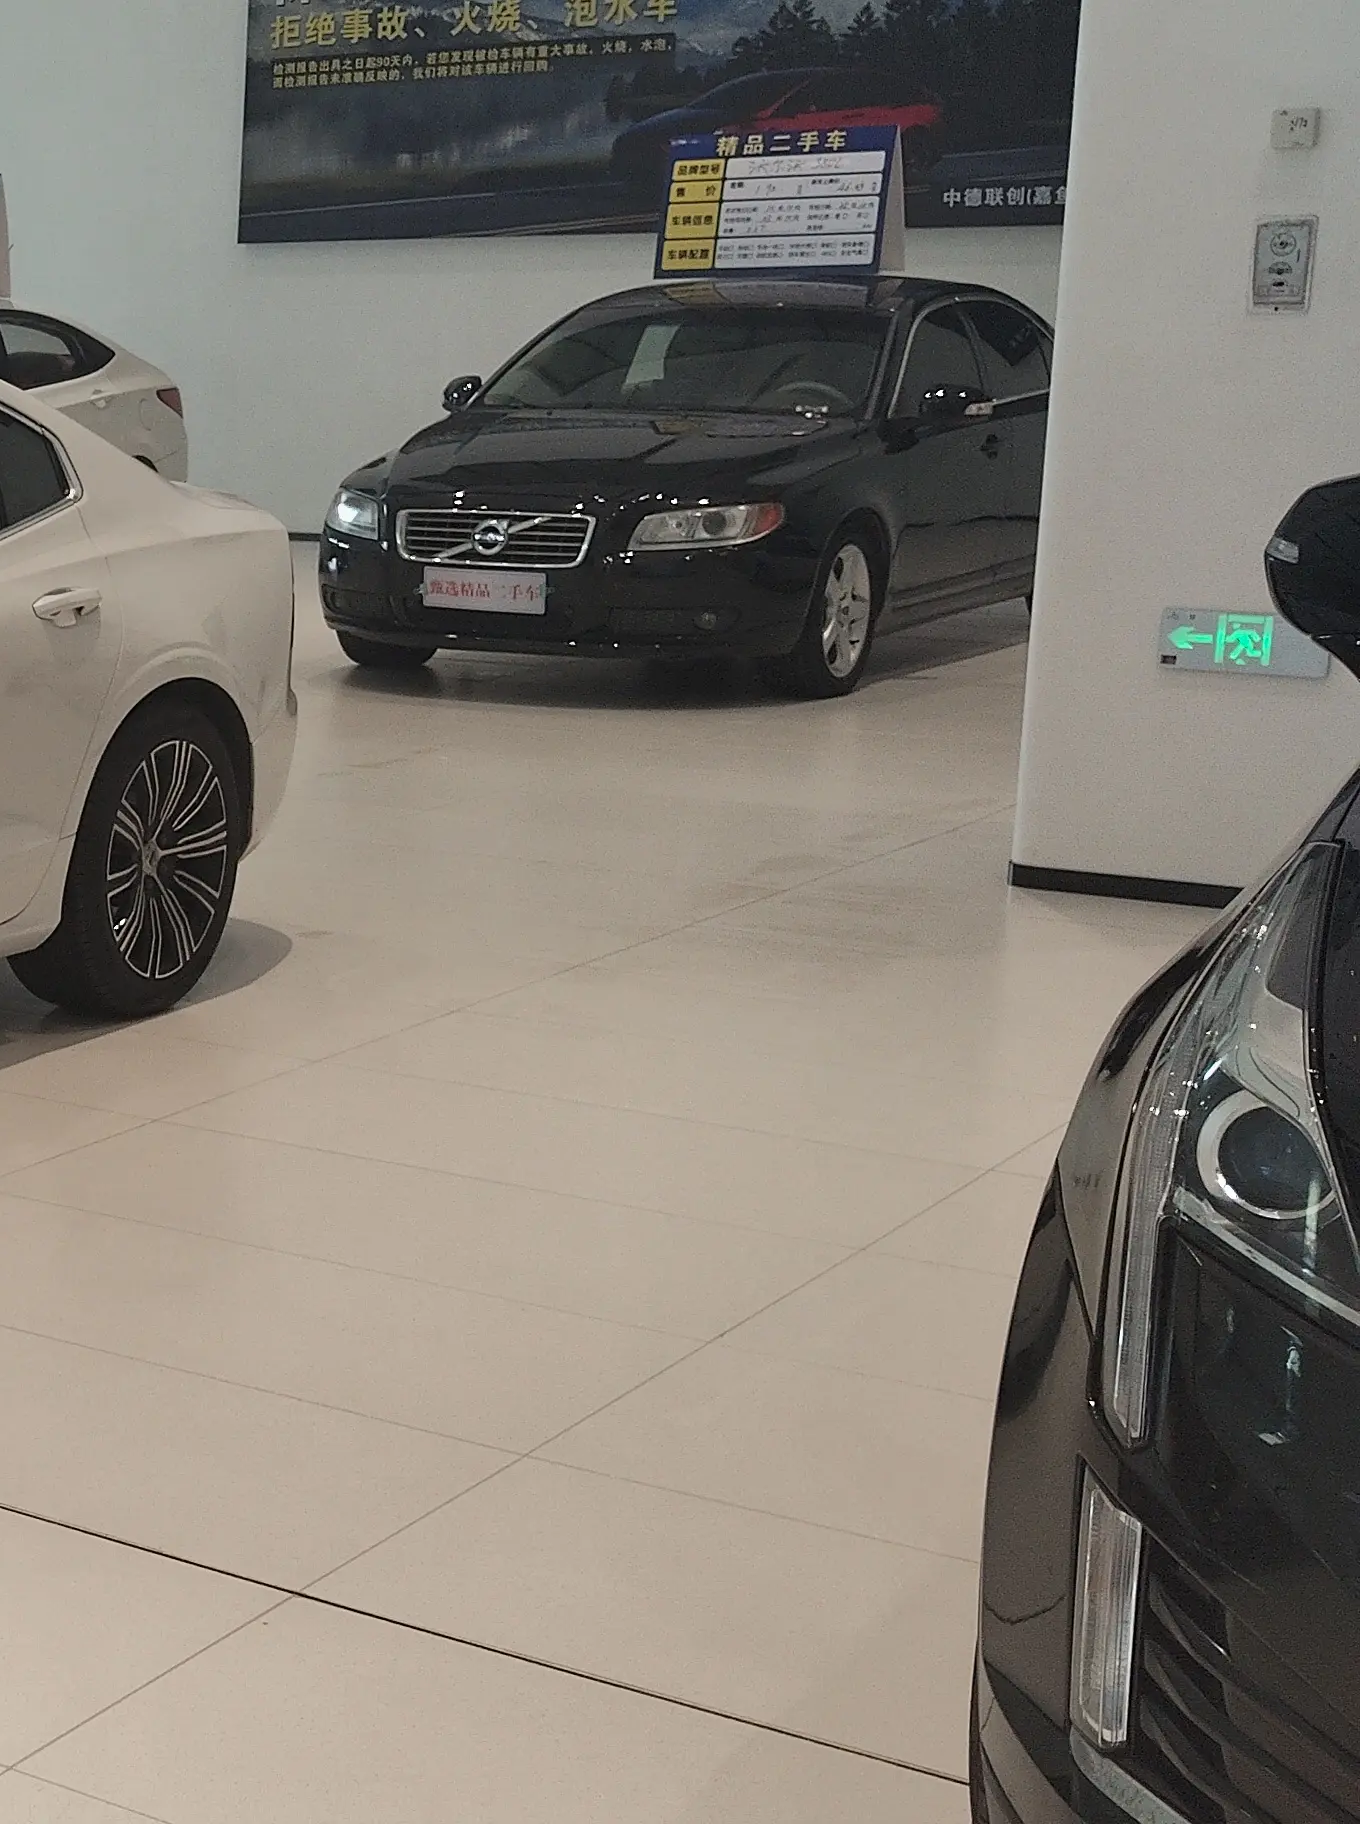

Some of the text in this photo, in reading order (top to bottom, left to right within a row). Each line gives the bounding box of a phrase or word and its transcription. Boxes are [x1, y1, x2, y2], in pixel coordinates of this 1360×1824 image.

[716, 130, 847, 157] 精品二手车
